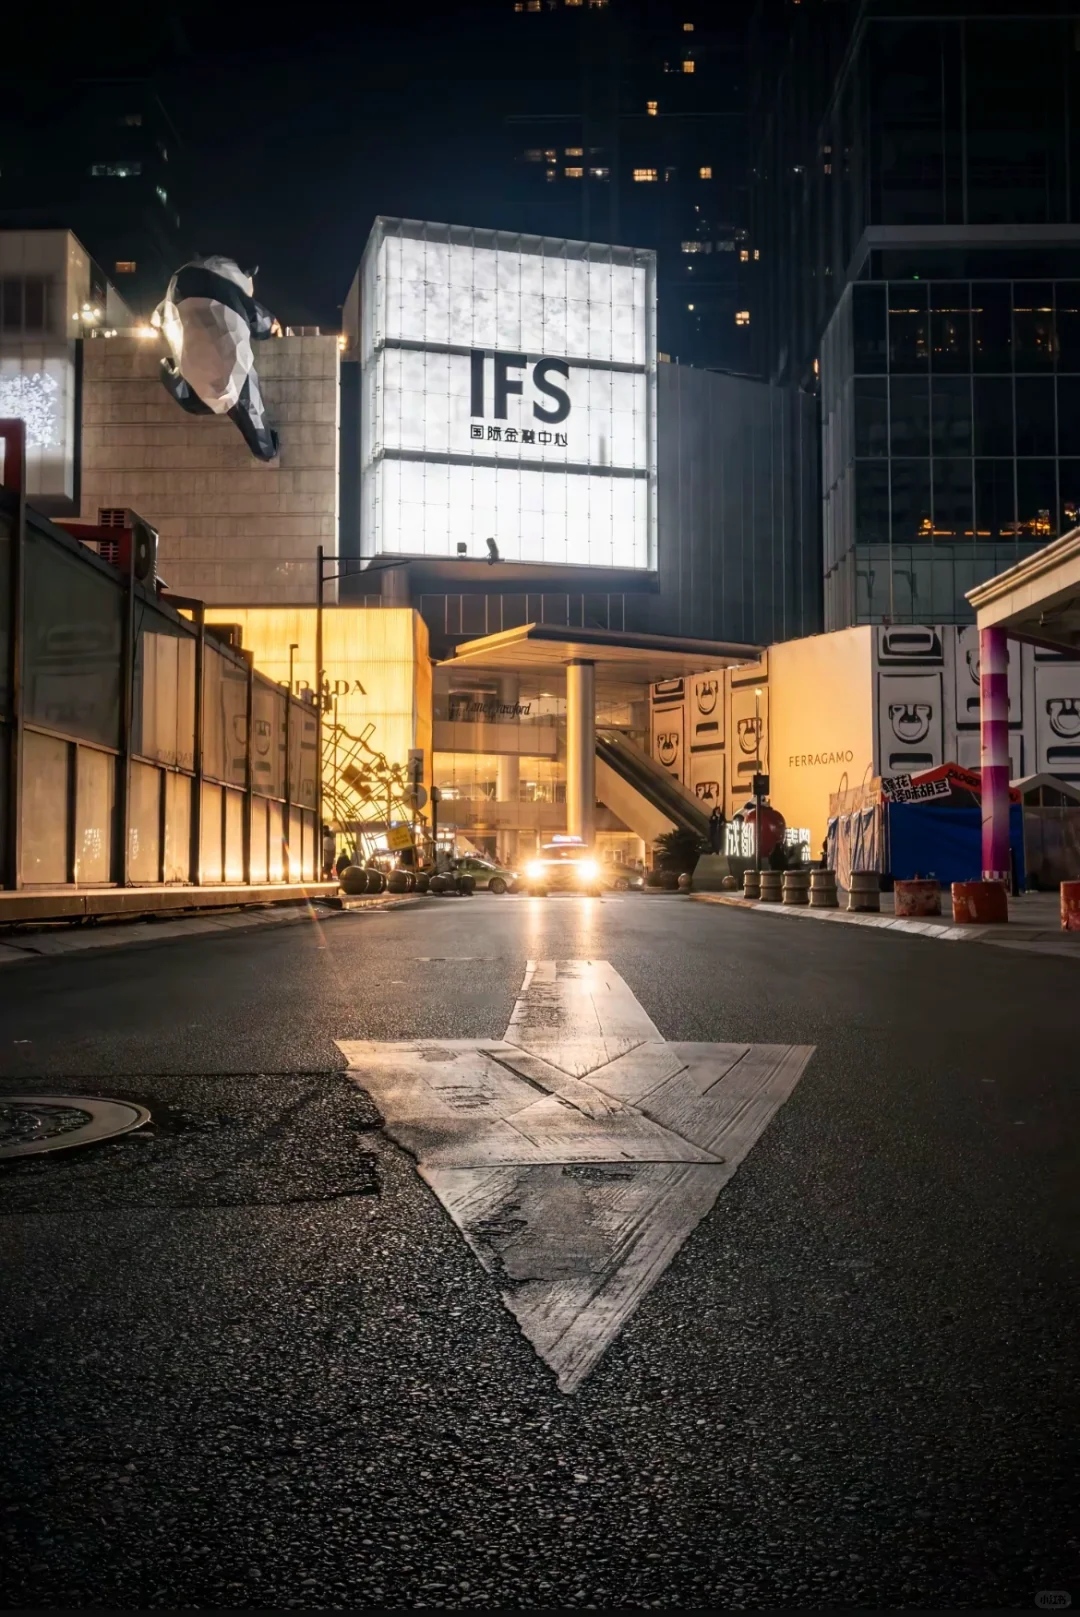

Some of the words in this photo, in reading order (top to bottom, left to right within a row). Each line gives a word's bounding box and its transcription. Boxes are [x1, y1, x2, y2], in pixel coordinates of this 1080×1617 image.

[470, 349, 571, 425] IFS
[470, 424, 568, 447] 国际金融中心
[788, 750, 854, 767] FERRAGAMO
[890, 780, 950, 803] 怪味胡豆
[725, 820, 755, 858] 成都
